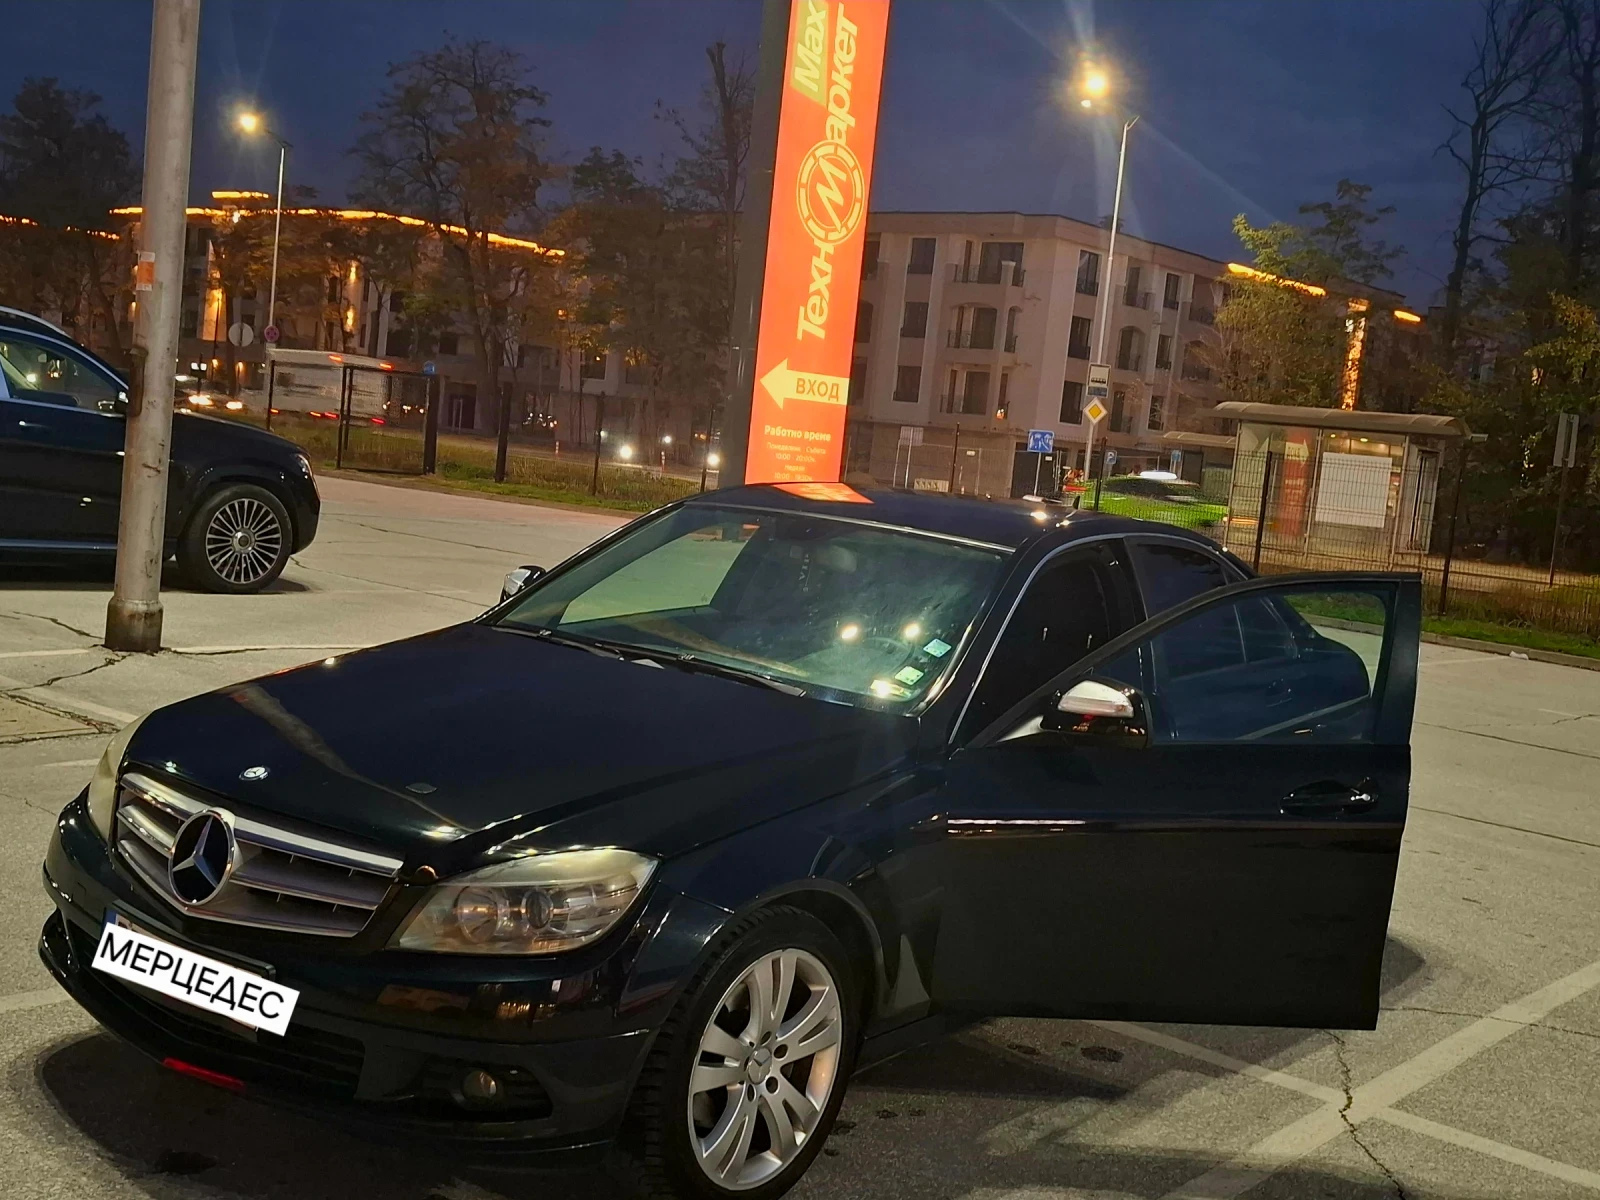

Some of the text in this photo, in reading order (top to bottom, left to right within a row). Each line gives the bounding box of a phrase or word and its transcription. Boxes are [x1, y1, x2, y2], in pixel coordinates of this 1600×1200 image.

[794, 0, 826, 92] Max
[796, 377, 840, 402] ВХОД
[764, 425, 831, 442] Работно време
